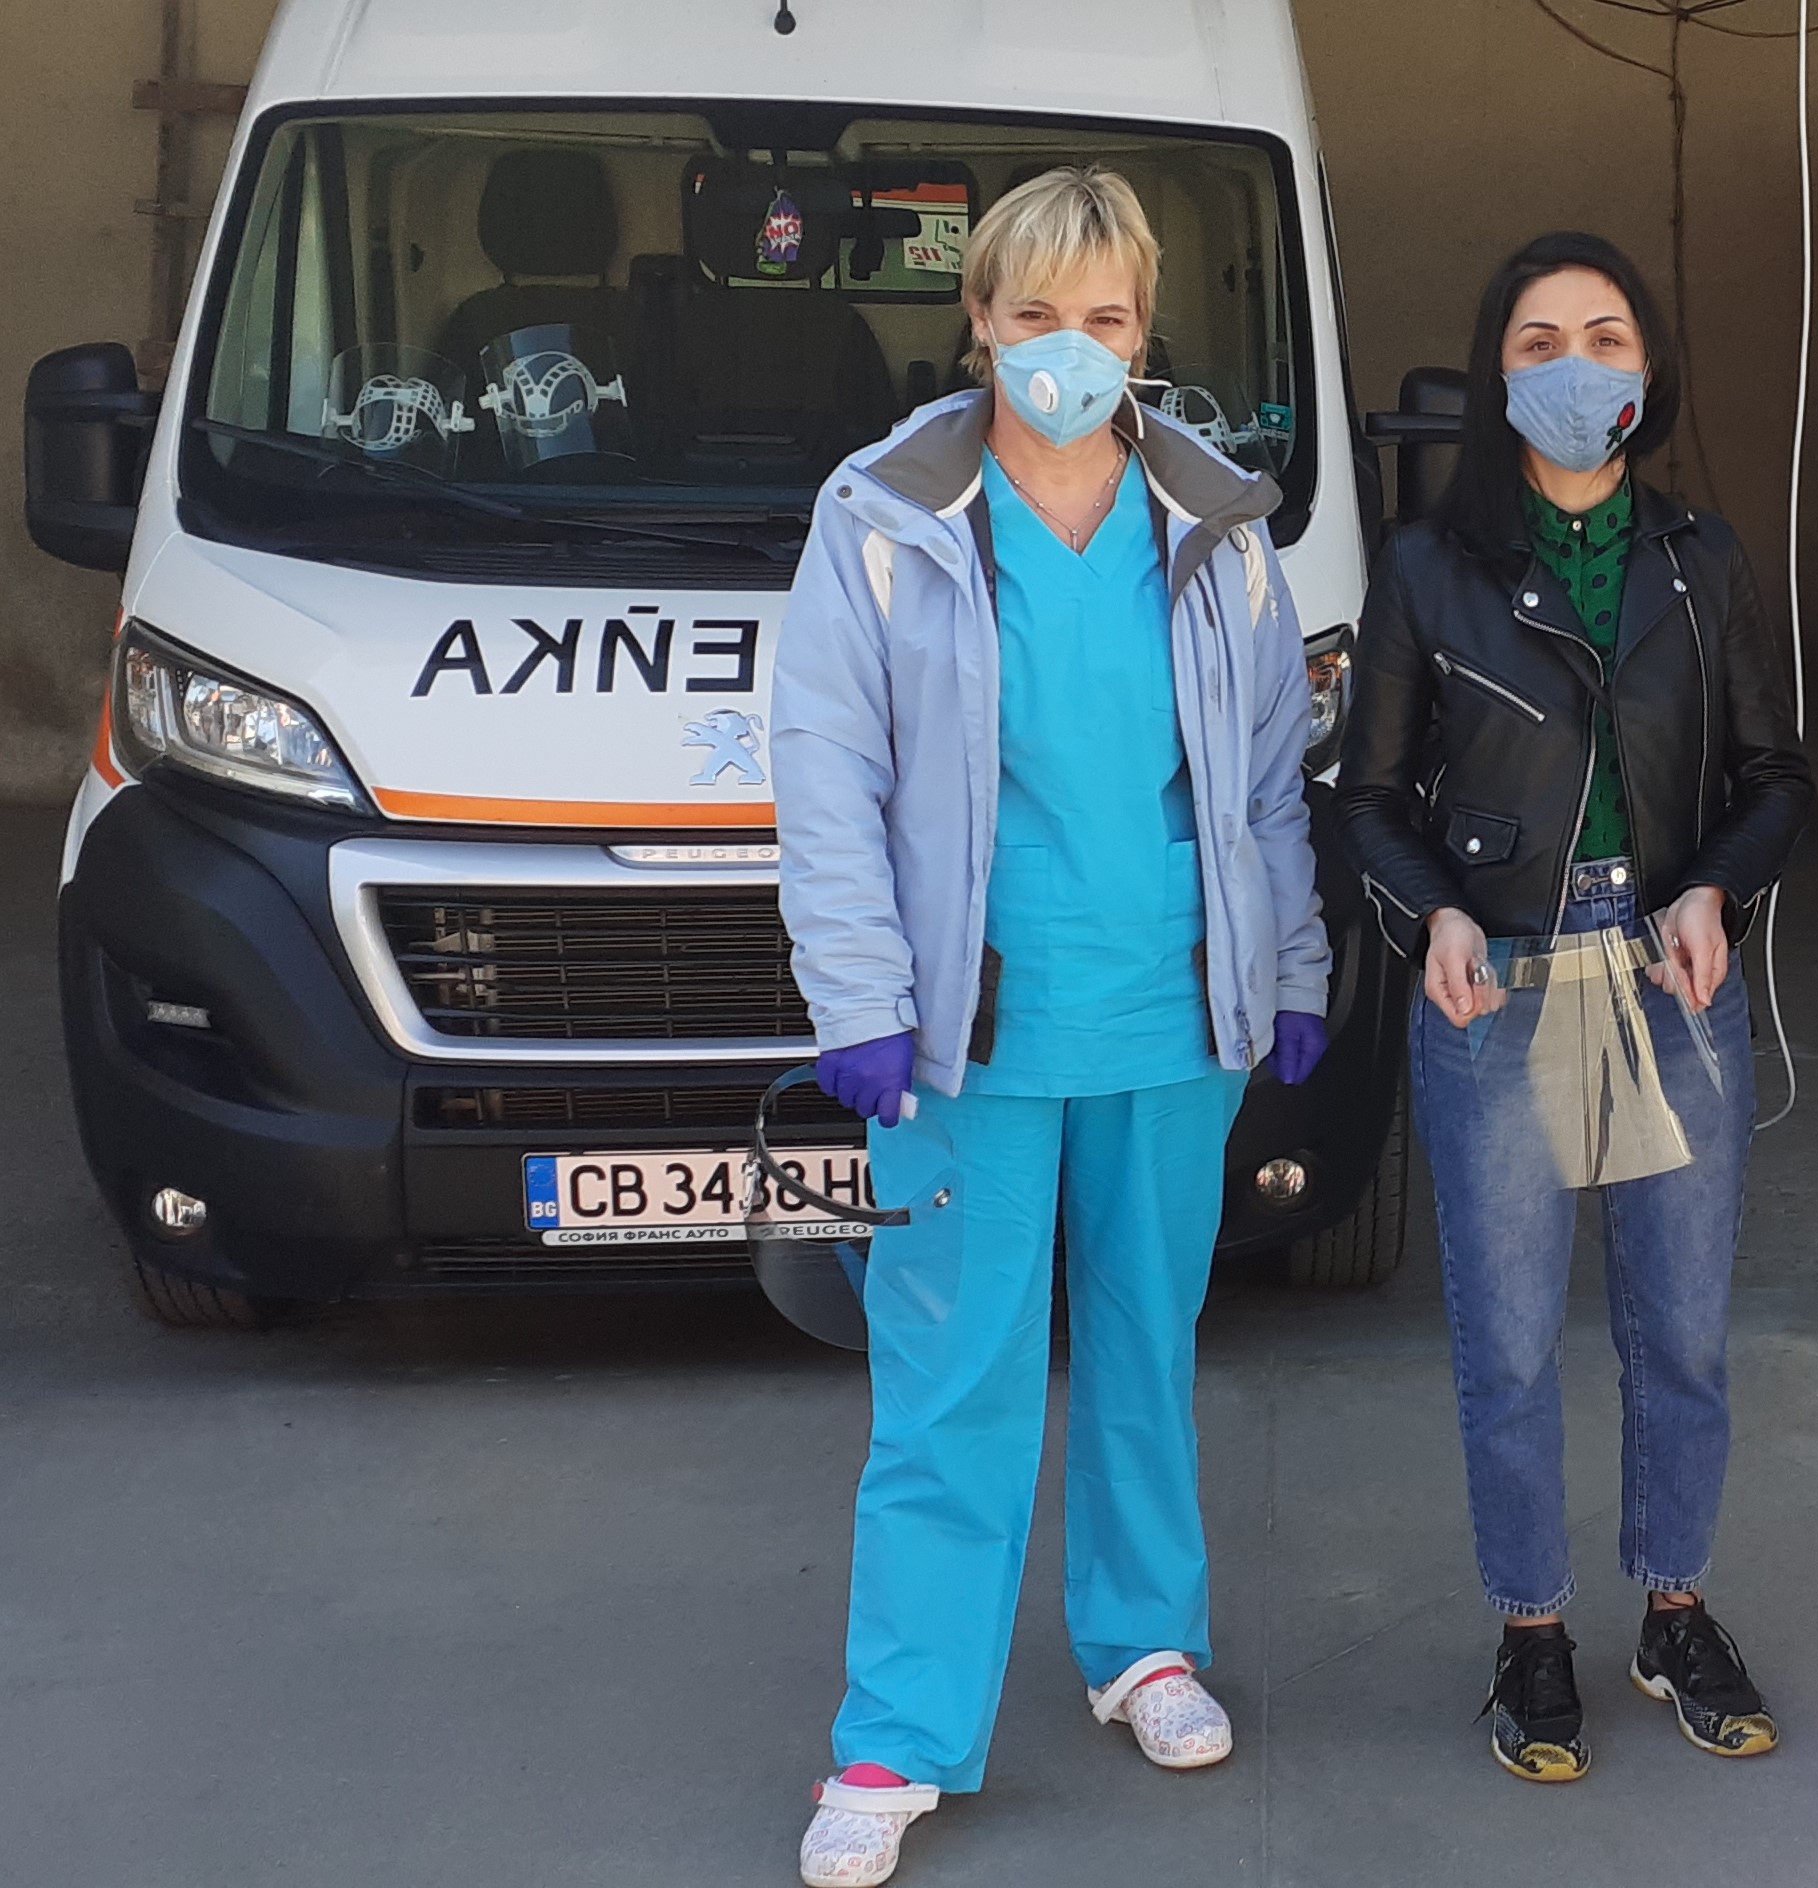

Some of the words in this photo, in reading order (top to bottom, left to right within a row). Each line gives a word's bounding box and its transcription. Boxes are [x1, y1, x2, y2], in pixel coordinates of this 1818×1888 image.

[767, 221, 799, 239] NO
[642, 848, 775, 859] PEUGEO
[569, 1163, 647, 1217] CB
[531, 1201, 557, 1219] BG
[558, 1231, 619, 1243] СОФИЯ
[624, 1229, 681, 1241] ФРАНС
[686, 1228, 729, 1240] АУТО
[779, 1224, 868, 1236] PEUGEO
